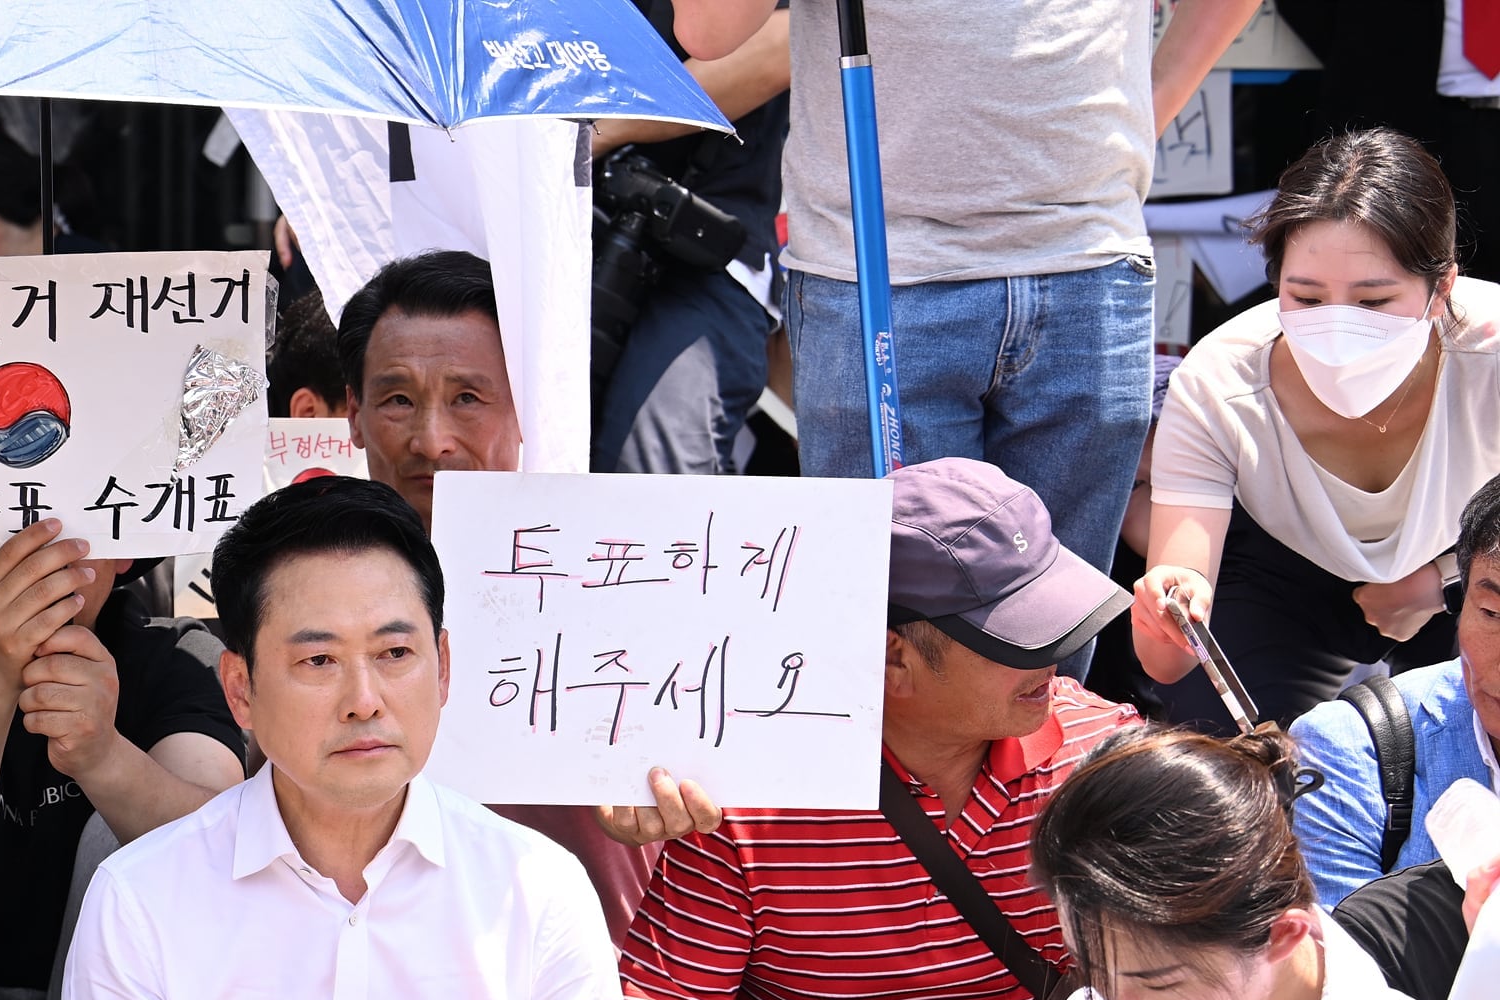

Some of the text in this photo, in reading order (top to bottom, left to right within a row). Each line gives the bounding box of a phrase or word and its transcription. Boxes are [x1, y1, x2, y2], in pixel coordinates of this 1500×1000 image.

[89, 268, 251, 333] 재선거
[84, 473, 242, 540] 수개표
[483, 510, 801, 613] 투표하게
[1013, 530, 1029, 554] S
[488, 630, 853, 747] 해주세요
